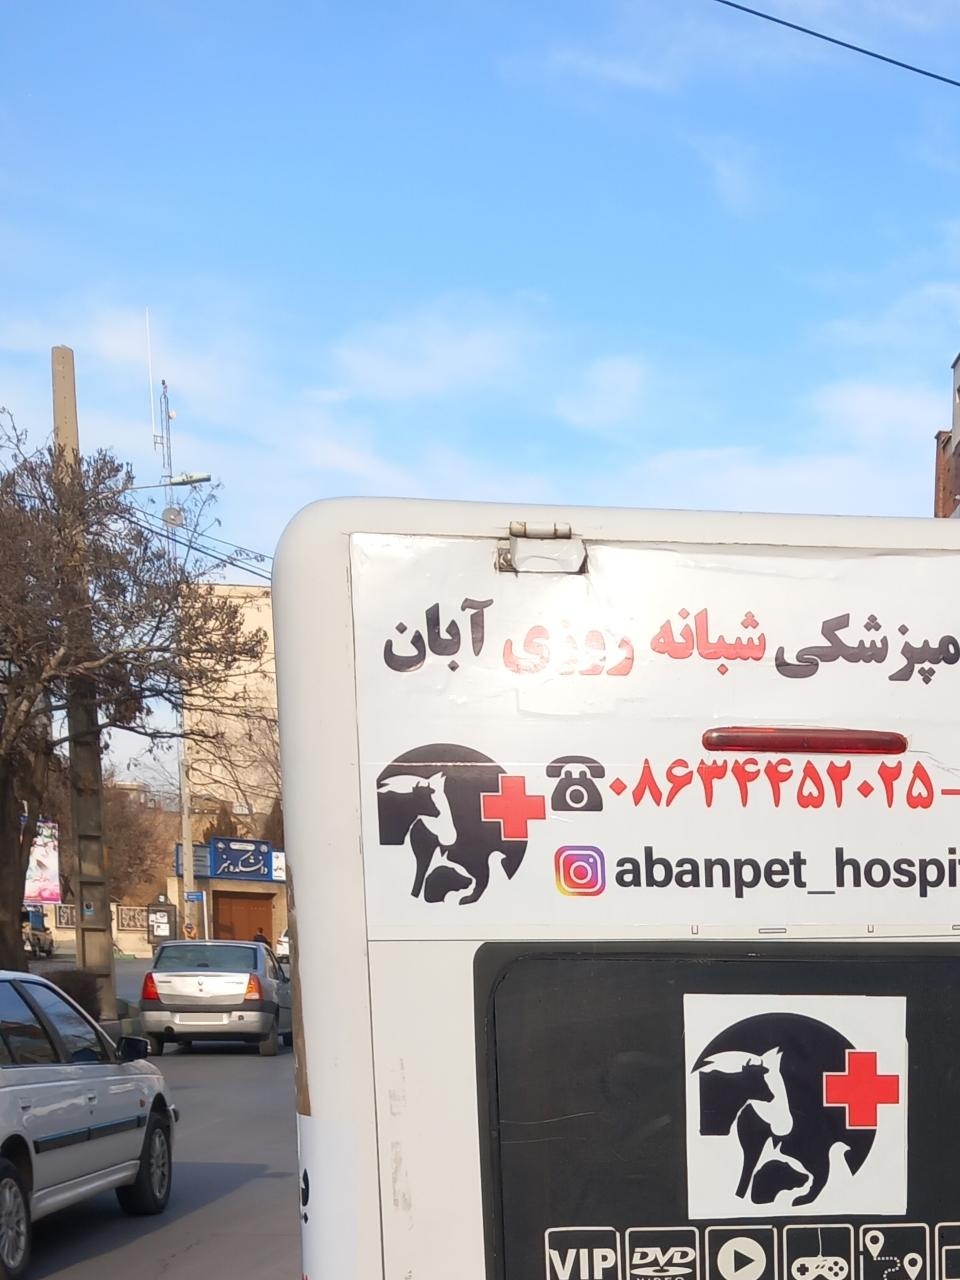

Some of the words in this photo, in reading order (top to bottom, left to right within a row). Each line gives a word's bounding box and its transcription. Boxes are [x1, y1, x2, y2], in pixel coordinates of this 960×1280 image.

[383, 597, 494, 673] آبان
[502, 620, 636, 676] روزی
[650, 608, 766, 675] شبانه
[229, 851, 268, 875] دانشکده
[549, 1248, 617, 1280] VIP
[631, 1246, 696, 1268] DVD
